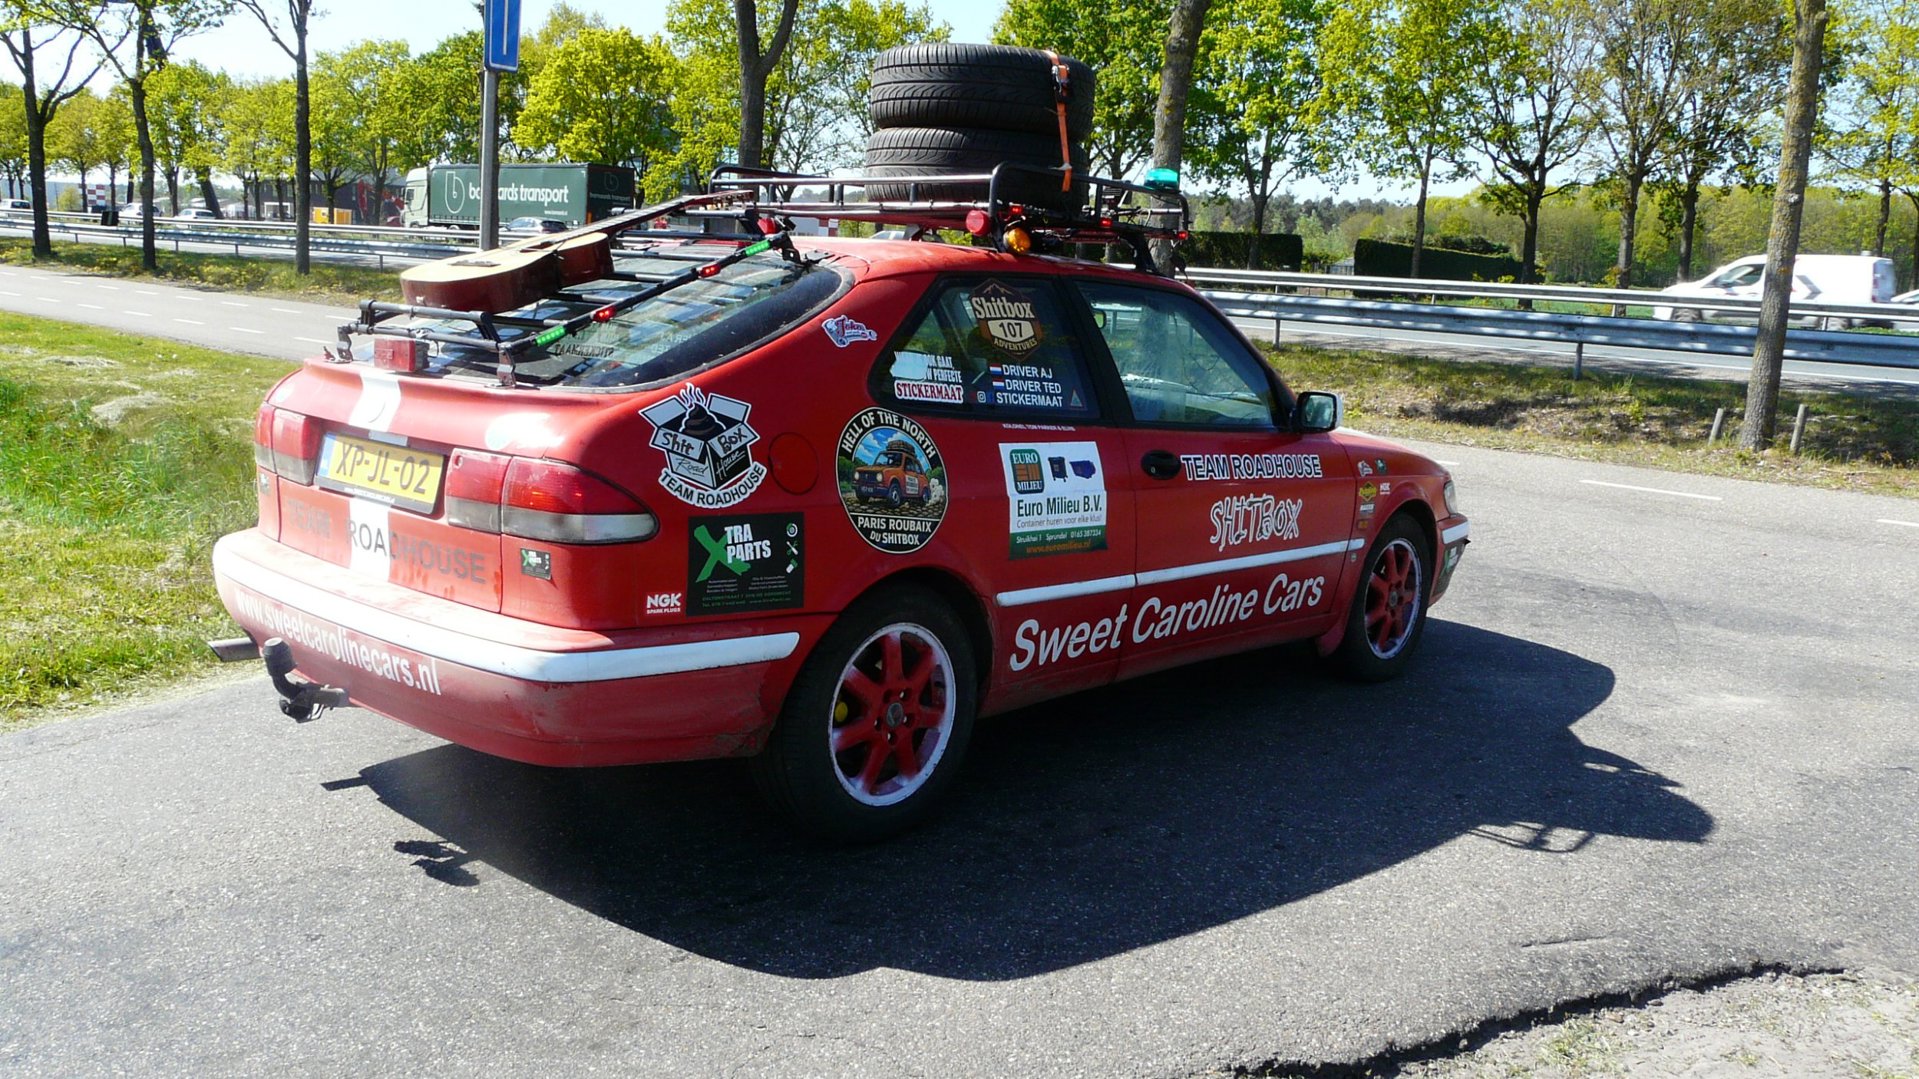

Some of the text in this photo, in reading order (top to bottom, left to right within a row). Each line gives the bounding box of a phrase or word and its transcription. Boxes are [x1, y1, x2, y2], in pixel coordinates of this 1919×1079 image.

[520, 184, 569, 206] transport
[972, 297, 1035, 319] Shitbox
[999, 322, 1023, 338] 107
[994, 338, 1038, 351] ADVENTURES
[933, 369, 962, 383] PERFECTE
[1002, 364, 1053, 379] DRIVER AJ
[896, 382, 962, 401] STICKERMAAT
[1005, 379, 1062, 394] DRIVER TED
[996, 392, 1063, 407] STICKERMAAT
[661, 432, 694, 455] Shit
[841, 411, 936, 459] HELL OF THE NORTH
[336, 442, 430, 494] XP-JL-02
[675, 450, 746, 480] Road House
[1011, 453, 1038, 465] EURO
[1181, 454, 1322, 480] TEAM ROADHOUSE
[659, 464, 765, 506] TEAM ROADHOUSE
[1017, 480, 1042, 491] MILIEU
[1017, 495, 1102, 517] Euro Milieu B.V.
[857, 516, 932, 533] PARIS ROUBAIX
[1017, 518, 1045, 529] Container
[1046, 516, 1063, 527] huren
[1078, 514, 1089, 523] elke
[1209, 493, 1303, 552] SHITBOX
[286, 500, 487, 584] TEAM ROADHOUSE
[882, 532, 920, 545] SHITBOX
[726, 540, 772, 564] PARTS
[646, 592, 682, 609] NGK
[1009, 572, 1325, 671] Sweet Caroline Cars
[235, 588, 441, 695] www.sweetcarolinecars.nl
